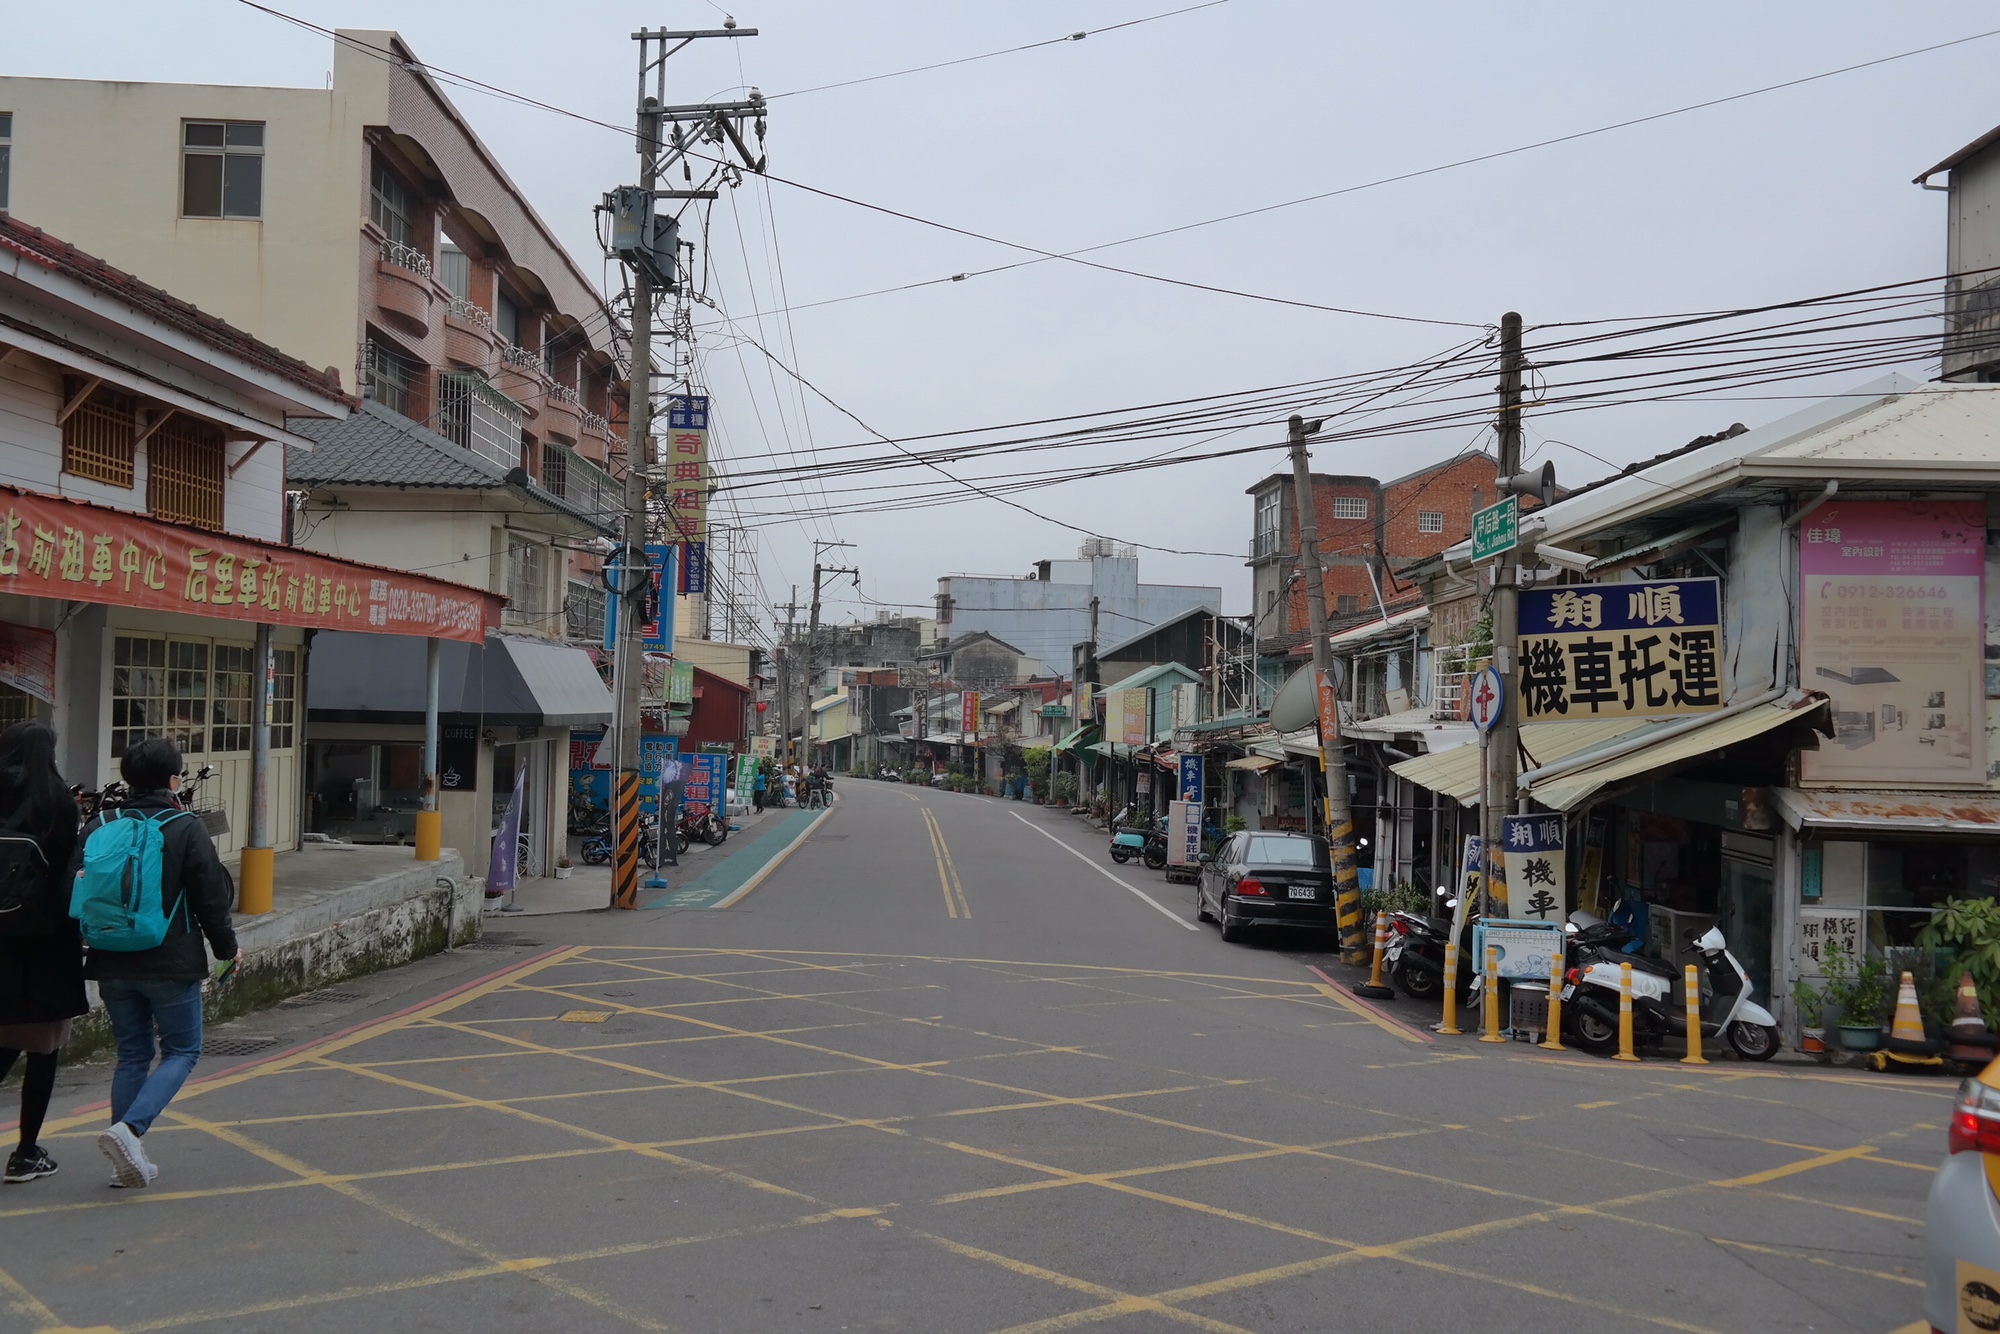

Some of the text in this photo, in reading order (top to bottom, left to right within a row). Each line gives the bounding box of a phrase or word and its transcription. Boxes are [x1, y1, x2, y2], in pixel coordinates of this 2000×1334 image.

[674, 433, 701, 537] 奇典租車
[1478, 502, 1515, 537] 甲后路一段
[1807, 528, 1842, 544] 佳瑋
[1841, 546, 1886, 557] 室內設計
[184, 547, 361, 619] 后里車站前租車中心
[1837, 586, 1947, 599] 0912-326646
[1547, 585, 1685, 628] 翔順
[1821, 606, 1873, 617] 室內設計
[1519, 630, 1719, 718] 機車托運
[445, 728, 474, 739] COFFEE
[1509, 820, 1563, 848] 翔順
[1522, 858, 1559, 920] 機車
